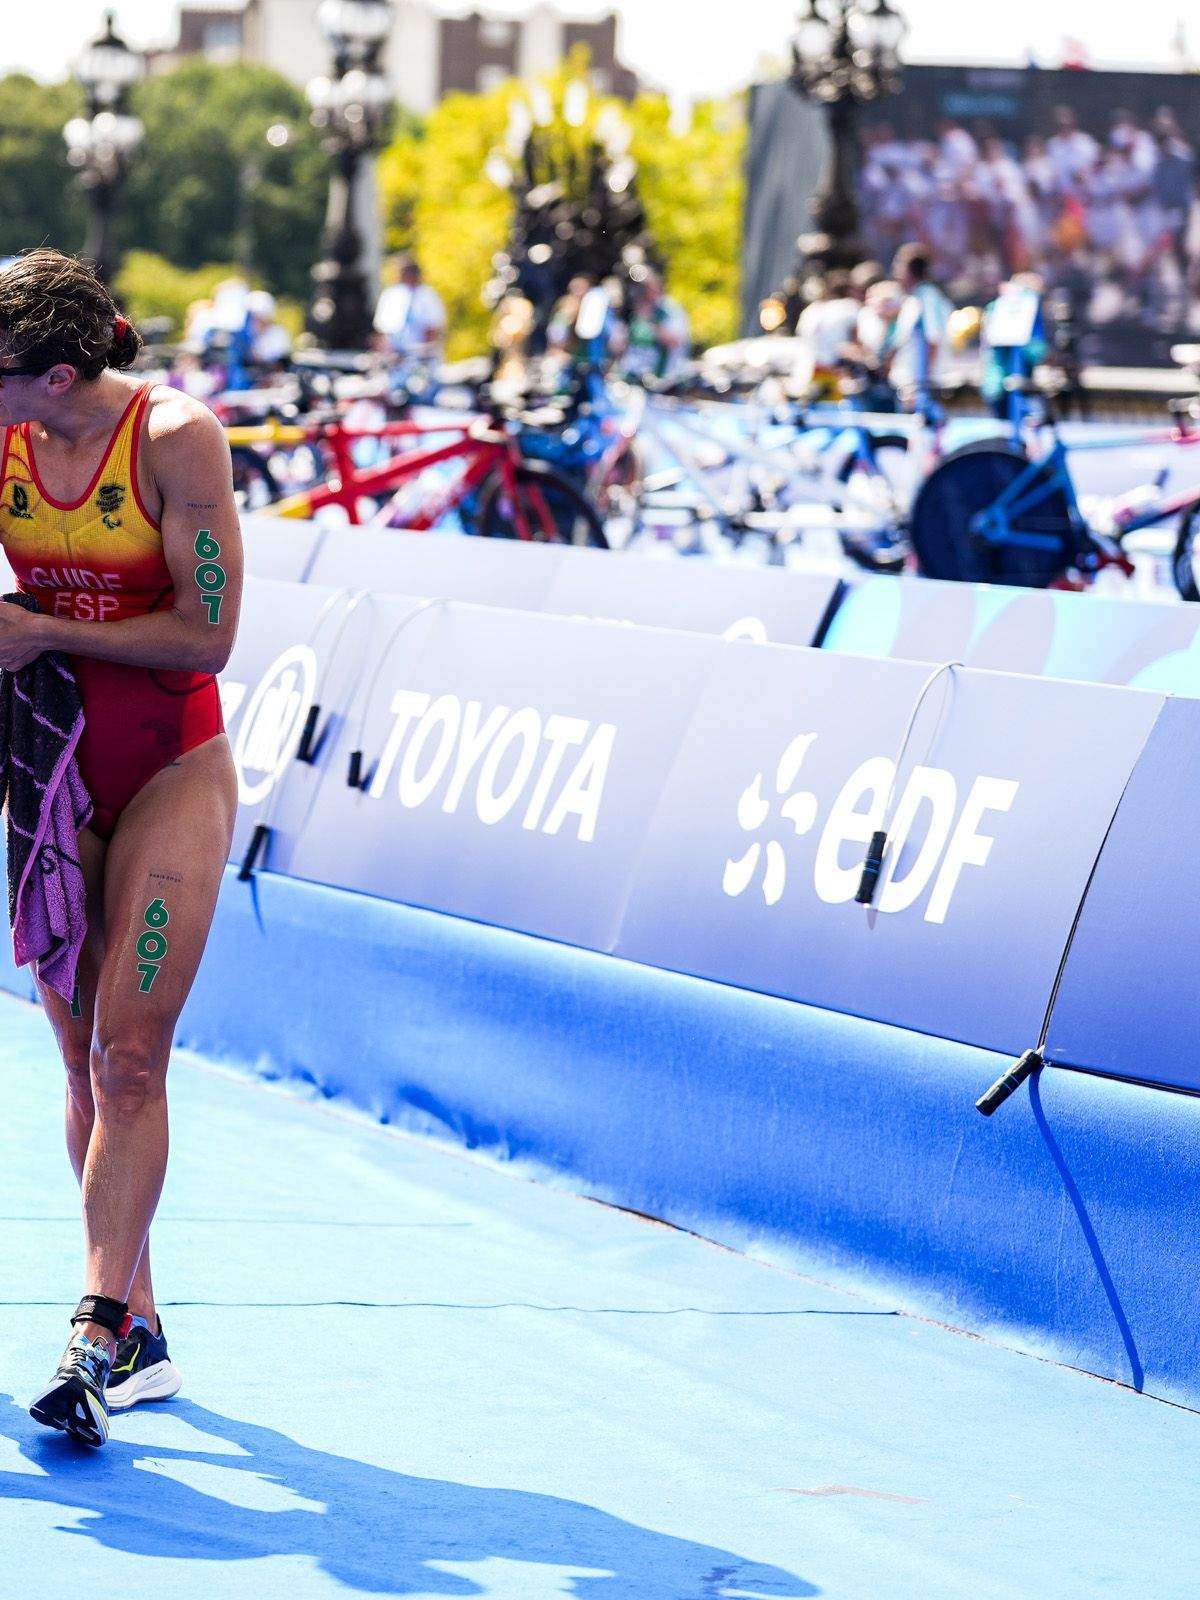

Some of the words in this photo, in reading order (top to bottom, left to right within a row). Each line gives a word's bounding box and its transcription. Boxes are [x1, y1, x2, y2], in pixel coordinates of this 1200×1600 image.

[54, 592, 120, 621] ESP
[194, 529, 227, 625] 607
[369, 689, 618, 843] TOYOTA
[136, 897, 170, 994] 607
